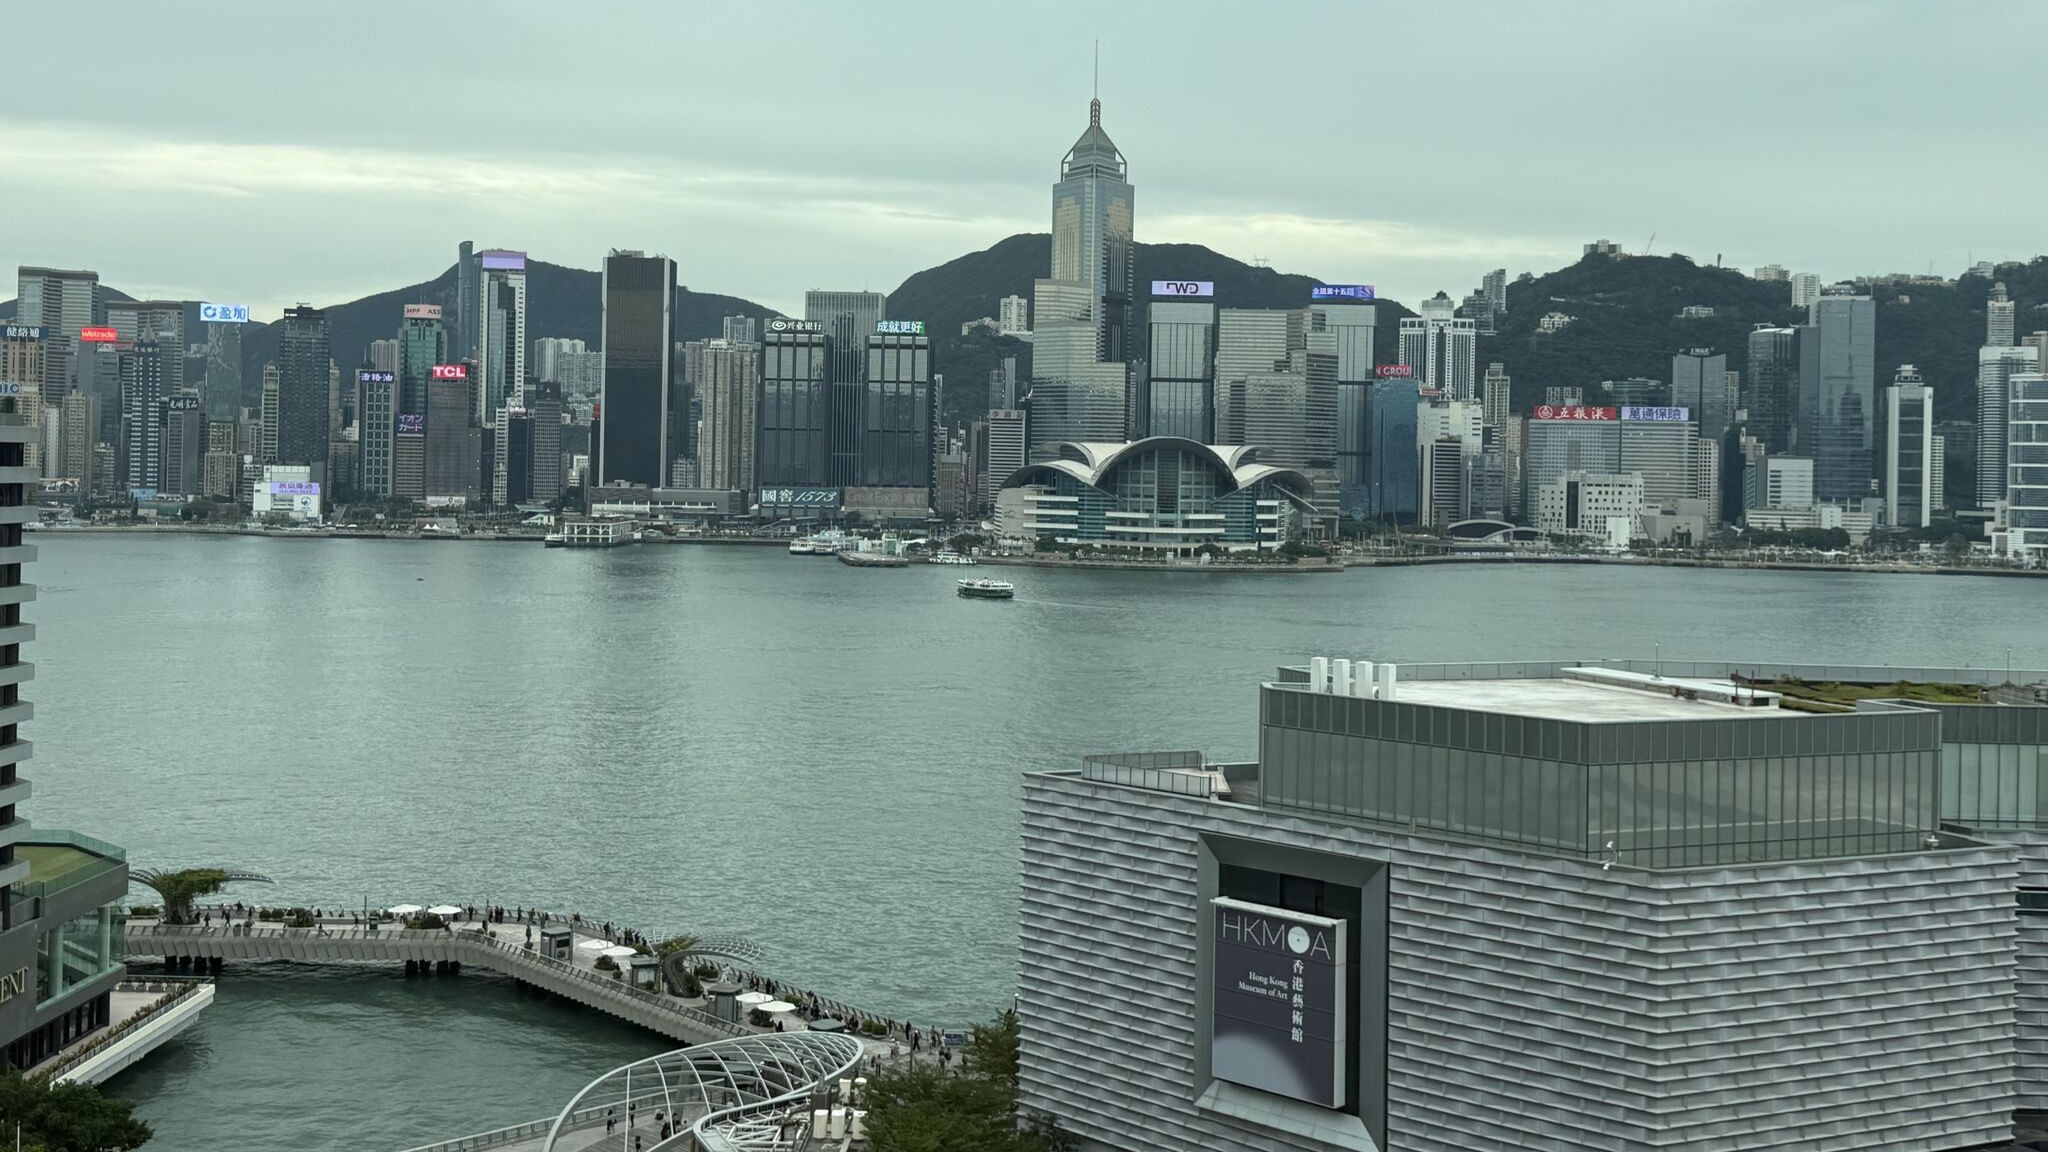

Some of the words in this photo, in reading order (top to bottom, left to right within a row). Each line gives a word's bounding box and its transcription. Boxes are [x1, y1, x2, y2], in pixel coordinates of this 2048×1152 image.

[219, 306, 246, 320] 盈加
[787, 321, 823, 332] 兴业银行
[877, 321, 923, 333] 成就更好
[432, 366, 466, 377] TCL
[169, 399, 198, 409] 光明食品
[399, 414, 424, 423] イオン
[1629, 407, 1681, 421] 萬通保險
[399, 423, 423, 432] カード
[795, 491, 837, 502] 1573
[1249, 971, 1268, 984] Hong
[1269, 975, 1288, 990] Kong
[1238, 980, 1267, 995] Museum
[1268, 988, 1277, 997] of
[1277, 990, 1288, 1000] Art
[1292, 959, 1304, 1043] 香港藝術館
